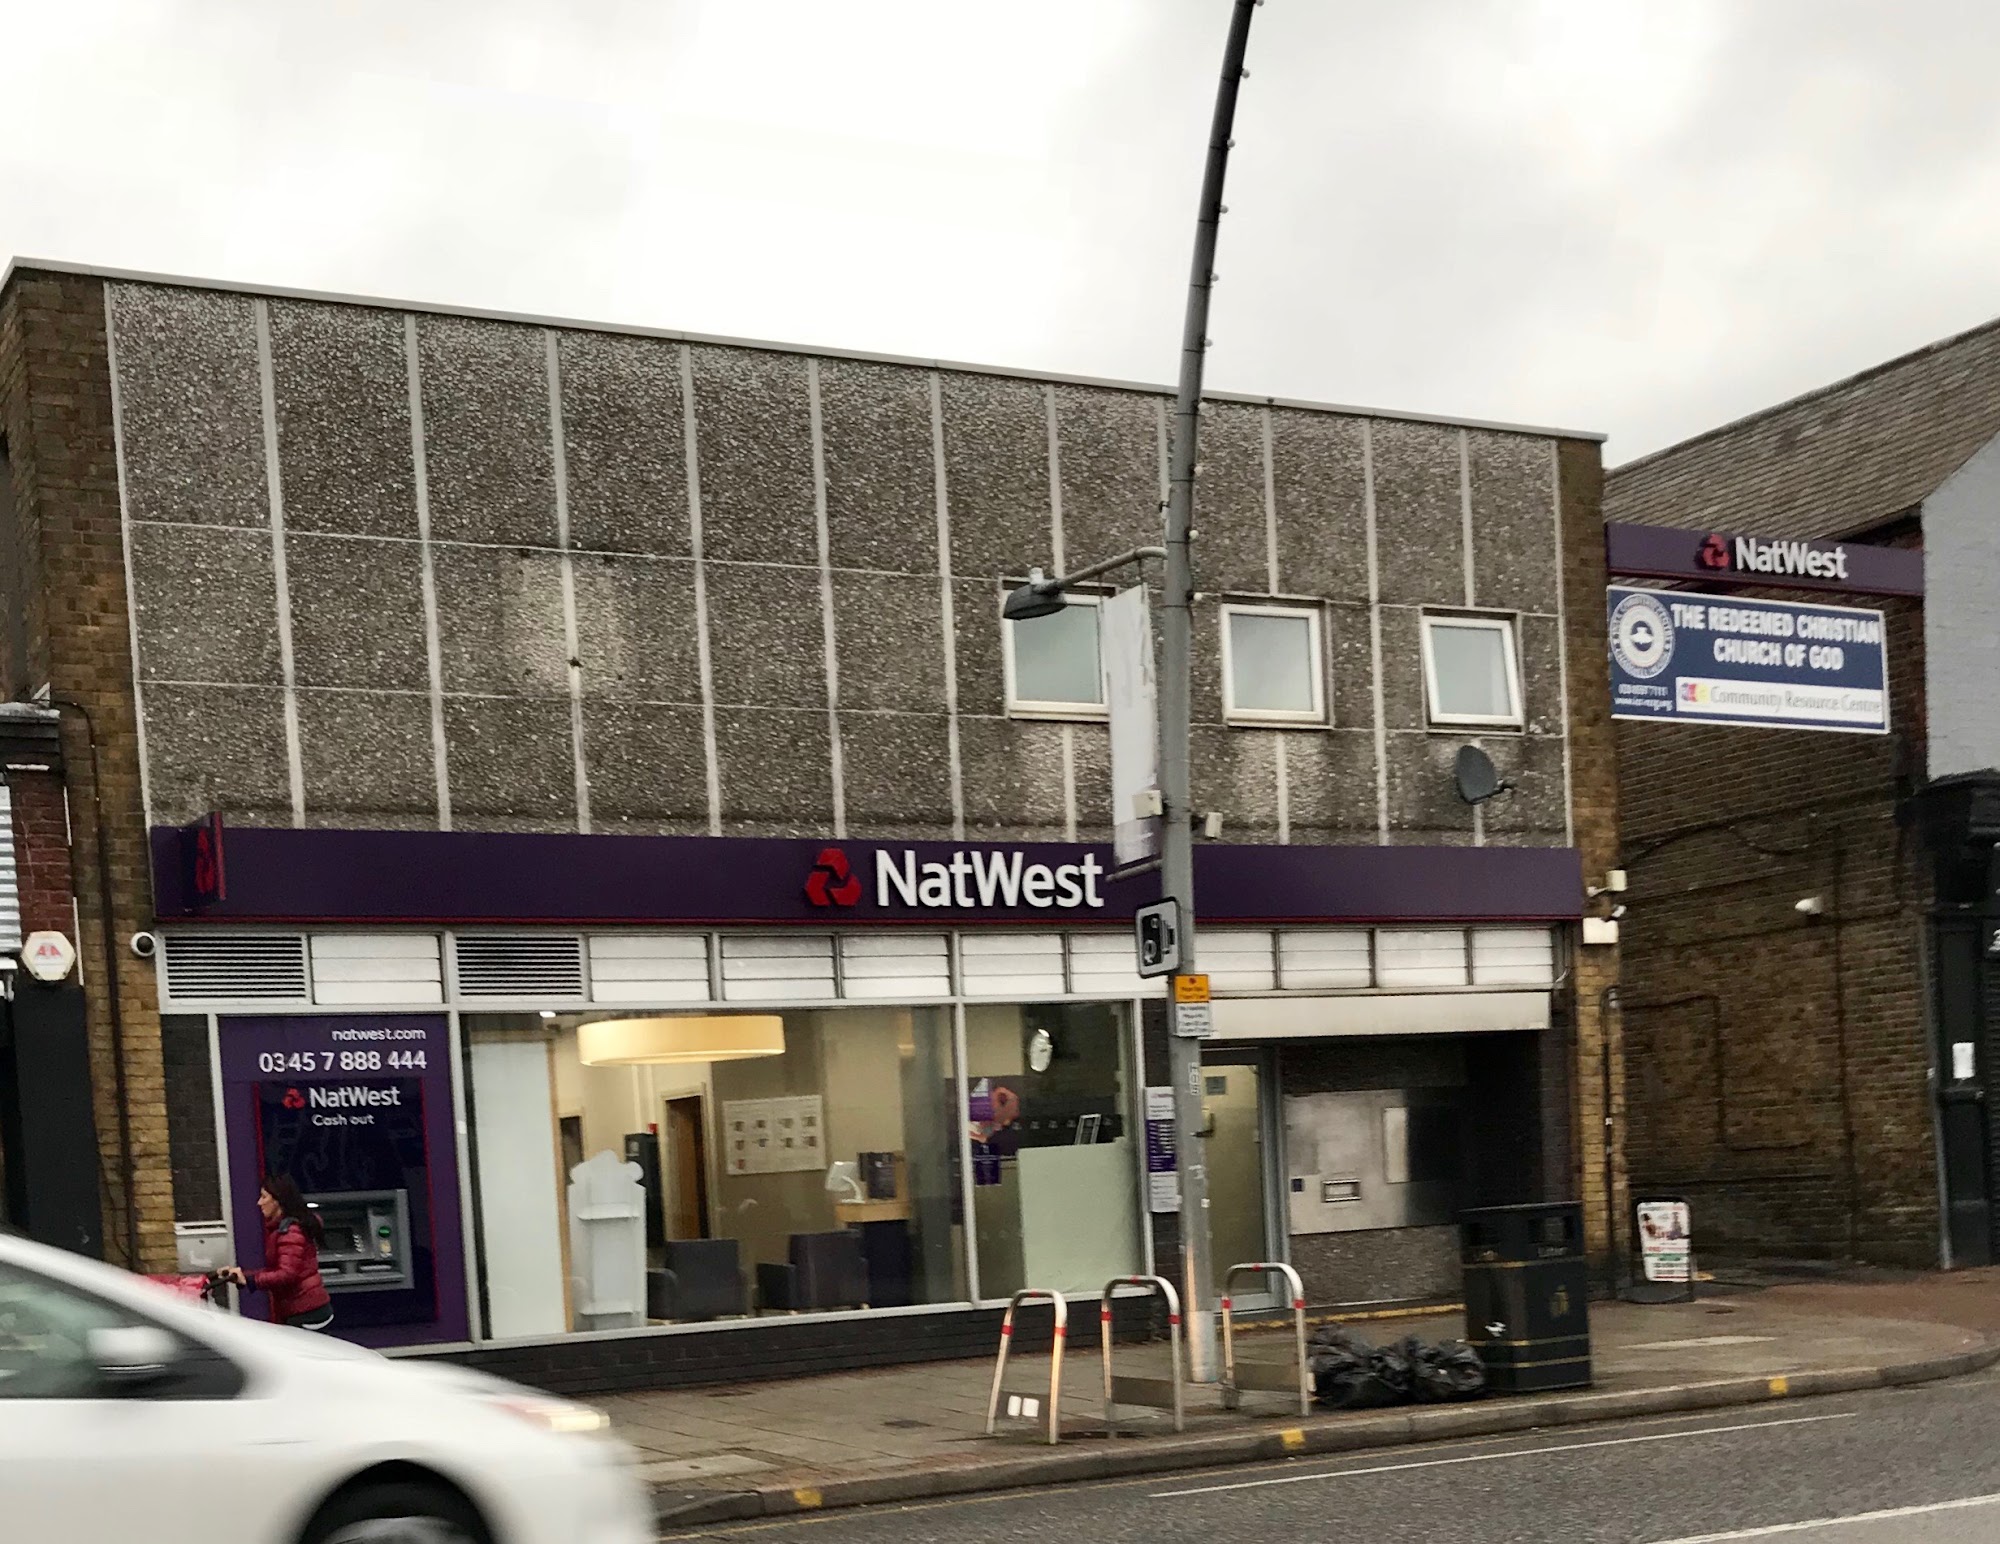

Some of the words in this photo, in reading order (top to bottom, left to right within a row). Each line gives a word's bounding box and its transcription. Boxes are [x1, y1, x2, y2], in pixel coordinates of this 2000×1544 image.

[1735, 536, 1849, 579] NatWest
[1671, 603, 1706, 630] THE
[1708, 606, 1794, 637] REDEEMED
[1797, 614, 1881, 644] CHRISTIAN
[1713, 637, 1782, 667] CHURCH
[1784, 643, 1807, 667] OF
[1809, 645, 1844, 670] GOD
[1710, 686, 1781, 713] Community
[1784, 690, 1840, 710] Resource
[1841, 694, 1882, 713] Centre
[875, 848, 1104, 908] NatWest
[331, 1028, 426, 1041] natwest.com
[258, 1052, 316, 1073] 0345
[319, 1051, 335, 1071] 7
[339, 1050, 381, 1071] 888
[387, 1049, 427, 1070] 444
[308, 1085, 401, 1109] NatWest
[311, 1113, 347, 1127] Cash
[350, 1113, 375, 1125] out
